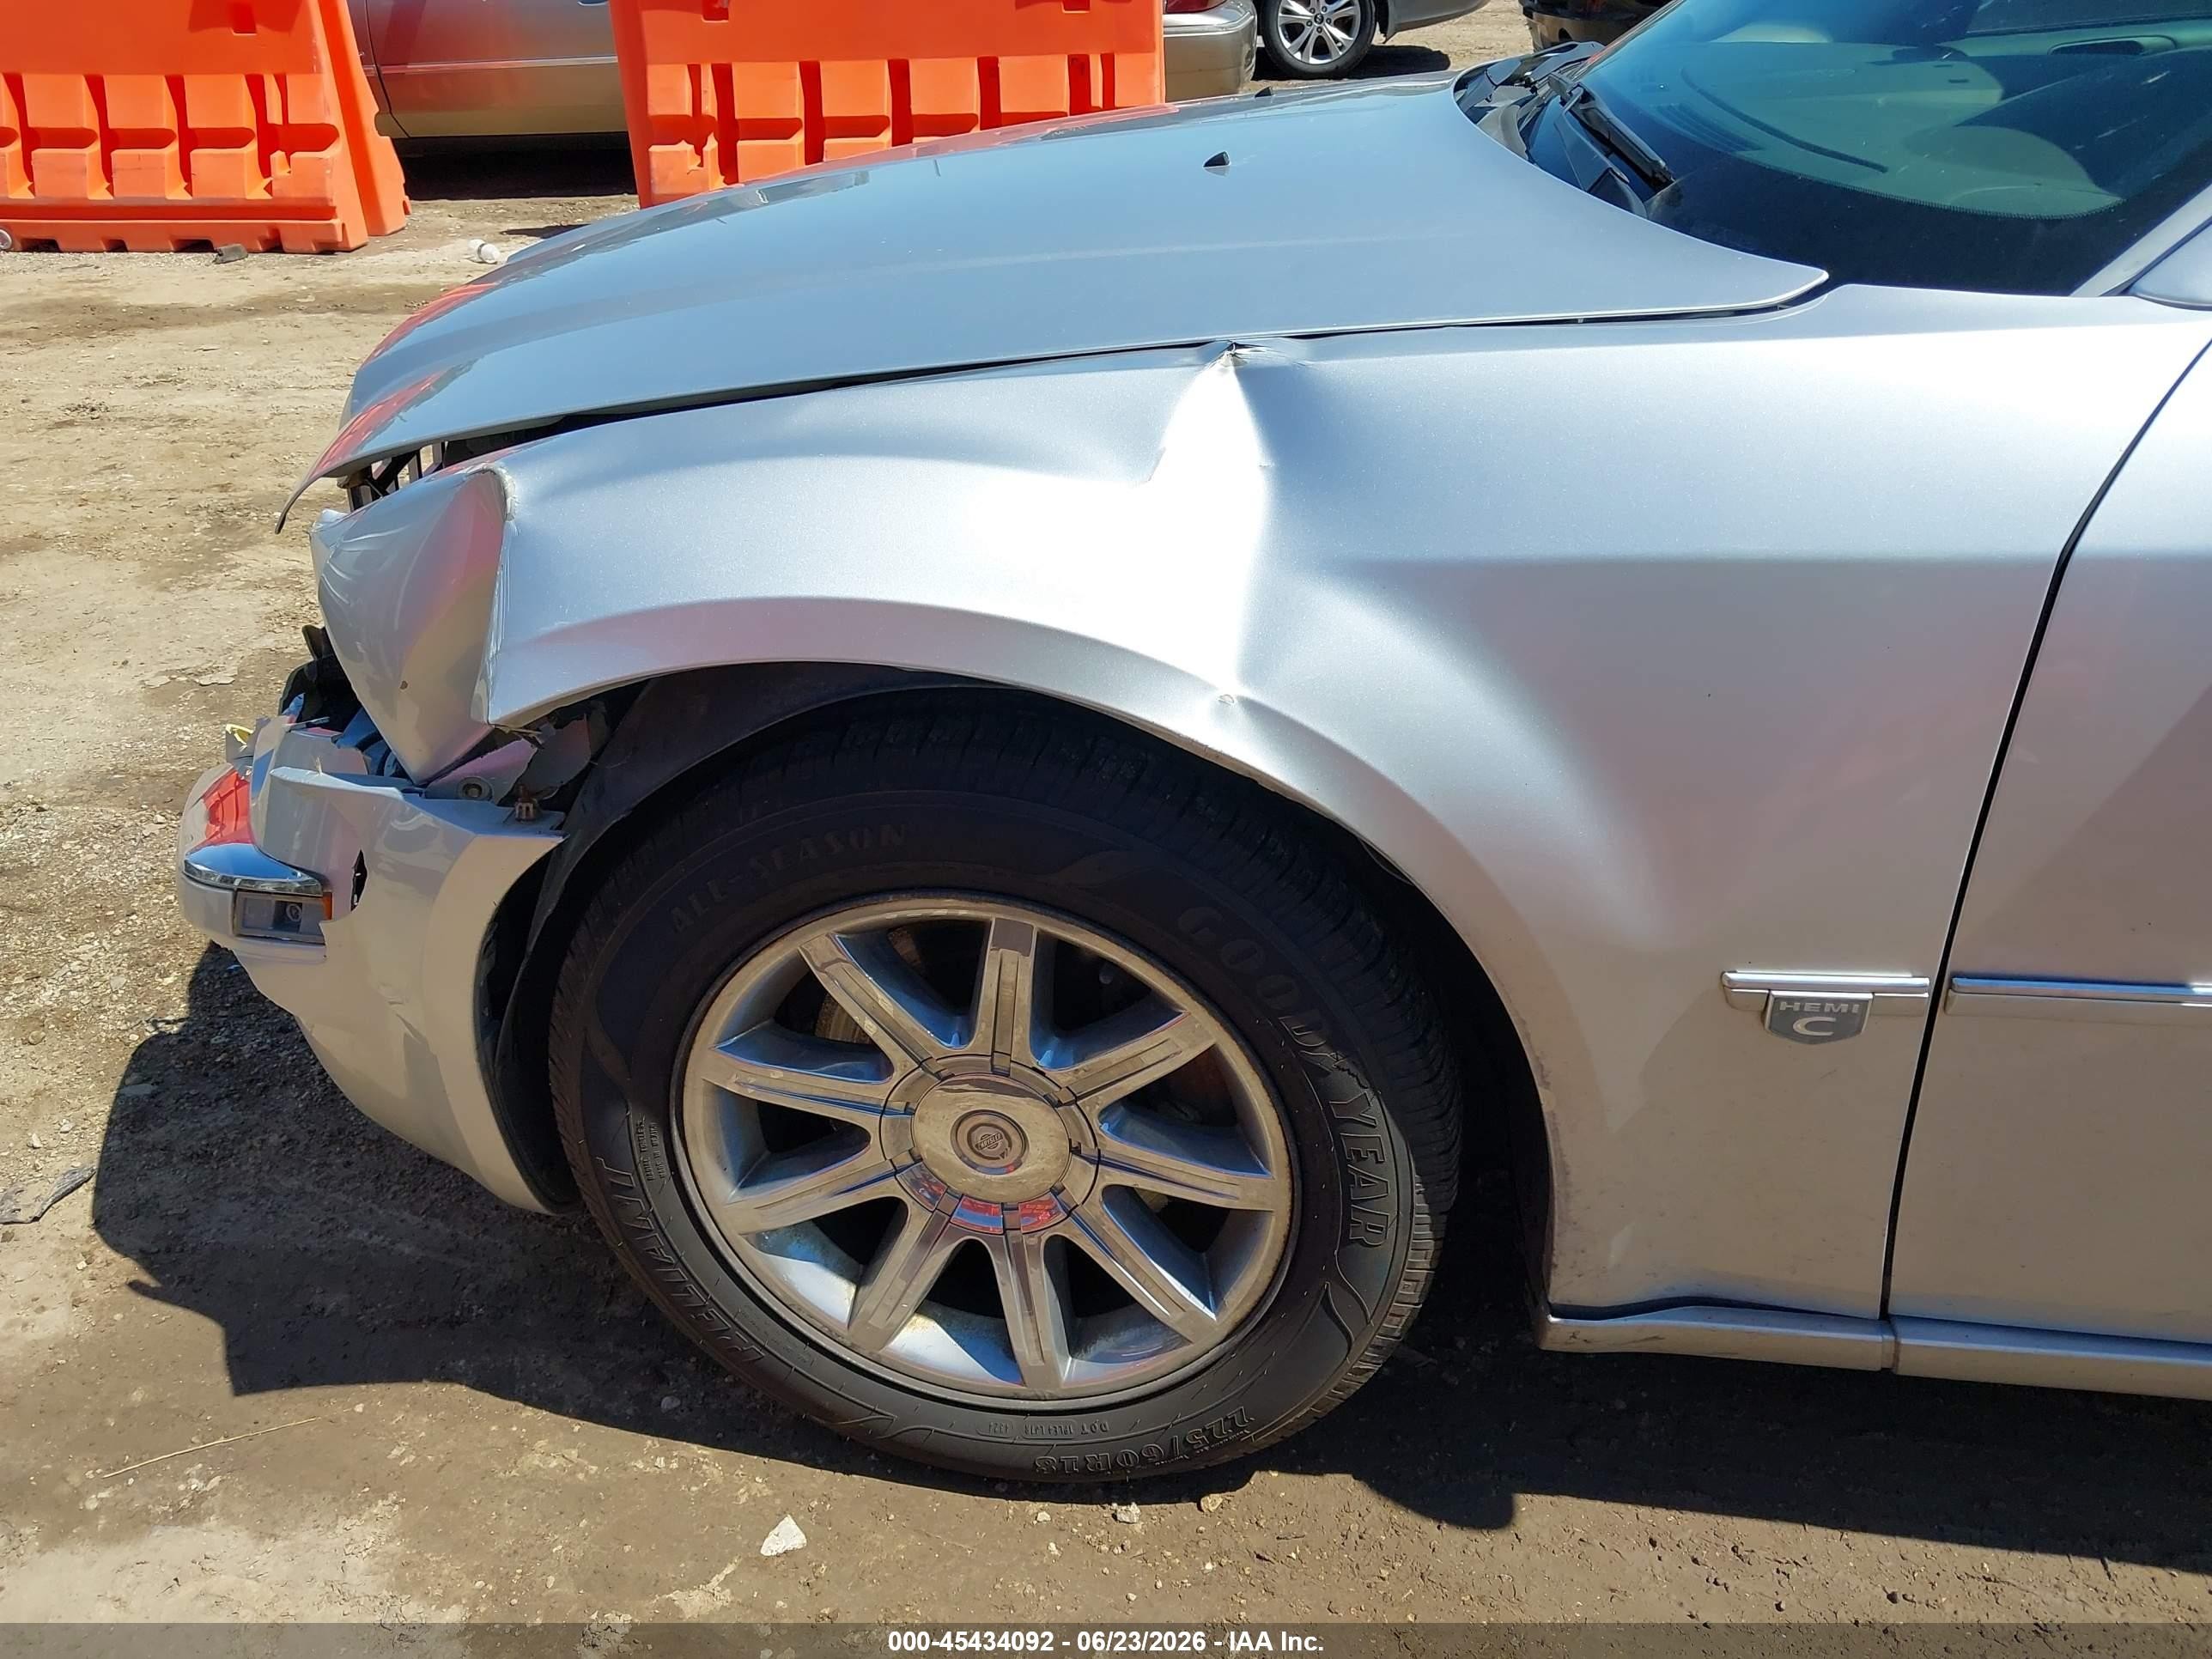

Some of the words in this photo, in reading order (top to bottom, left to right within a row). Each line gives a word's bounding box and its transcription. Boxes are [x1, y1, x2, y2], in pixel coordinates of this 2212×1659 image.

[669, 823, 907, 934] ALL-SEASON
[1779, 1000, 1861, 1014] HEMI
[1792, 1016, 1837, 1036] C
[595, 1155, 766, 1364] RELIANT
[1033, 1406, 1255, 1474] 225/60R18
[1080, 1421, 1110, 1436] DOT
